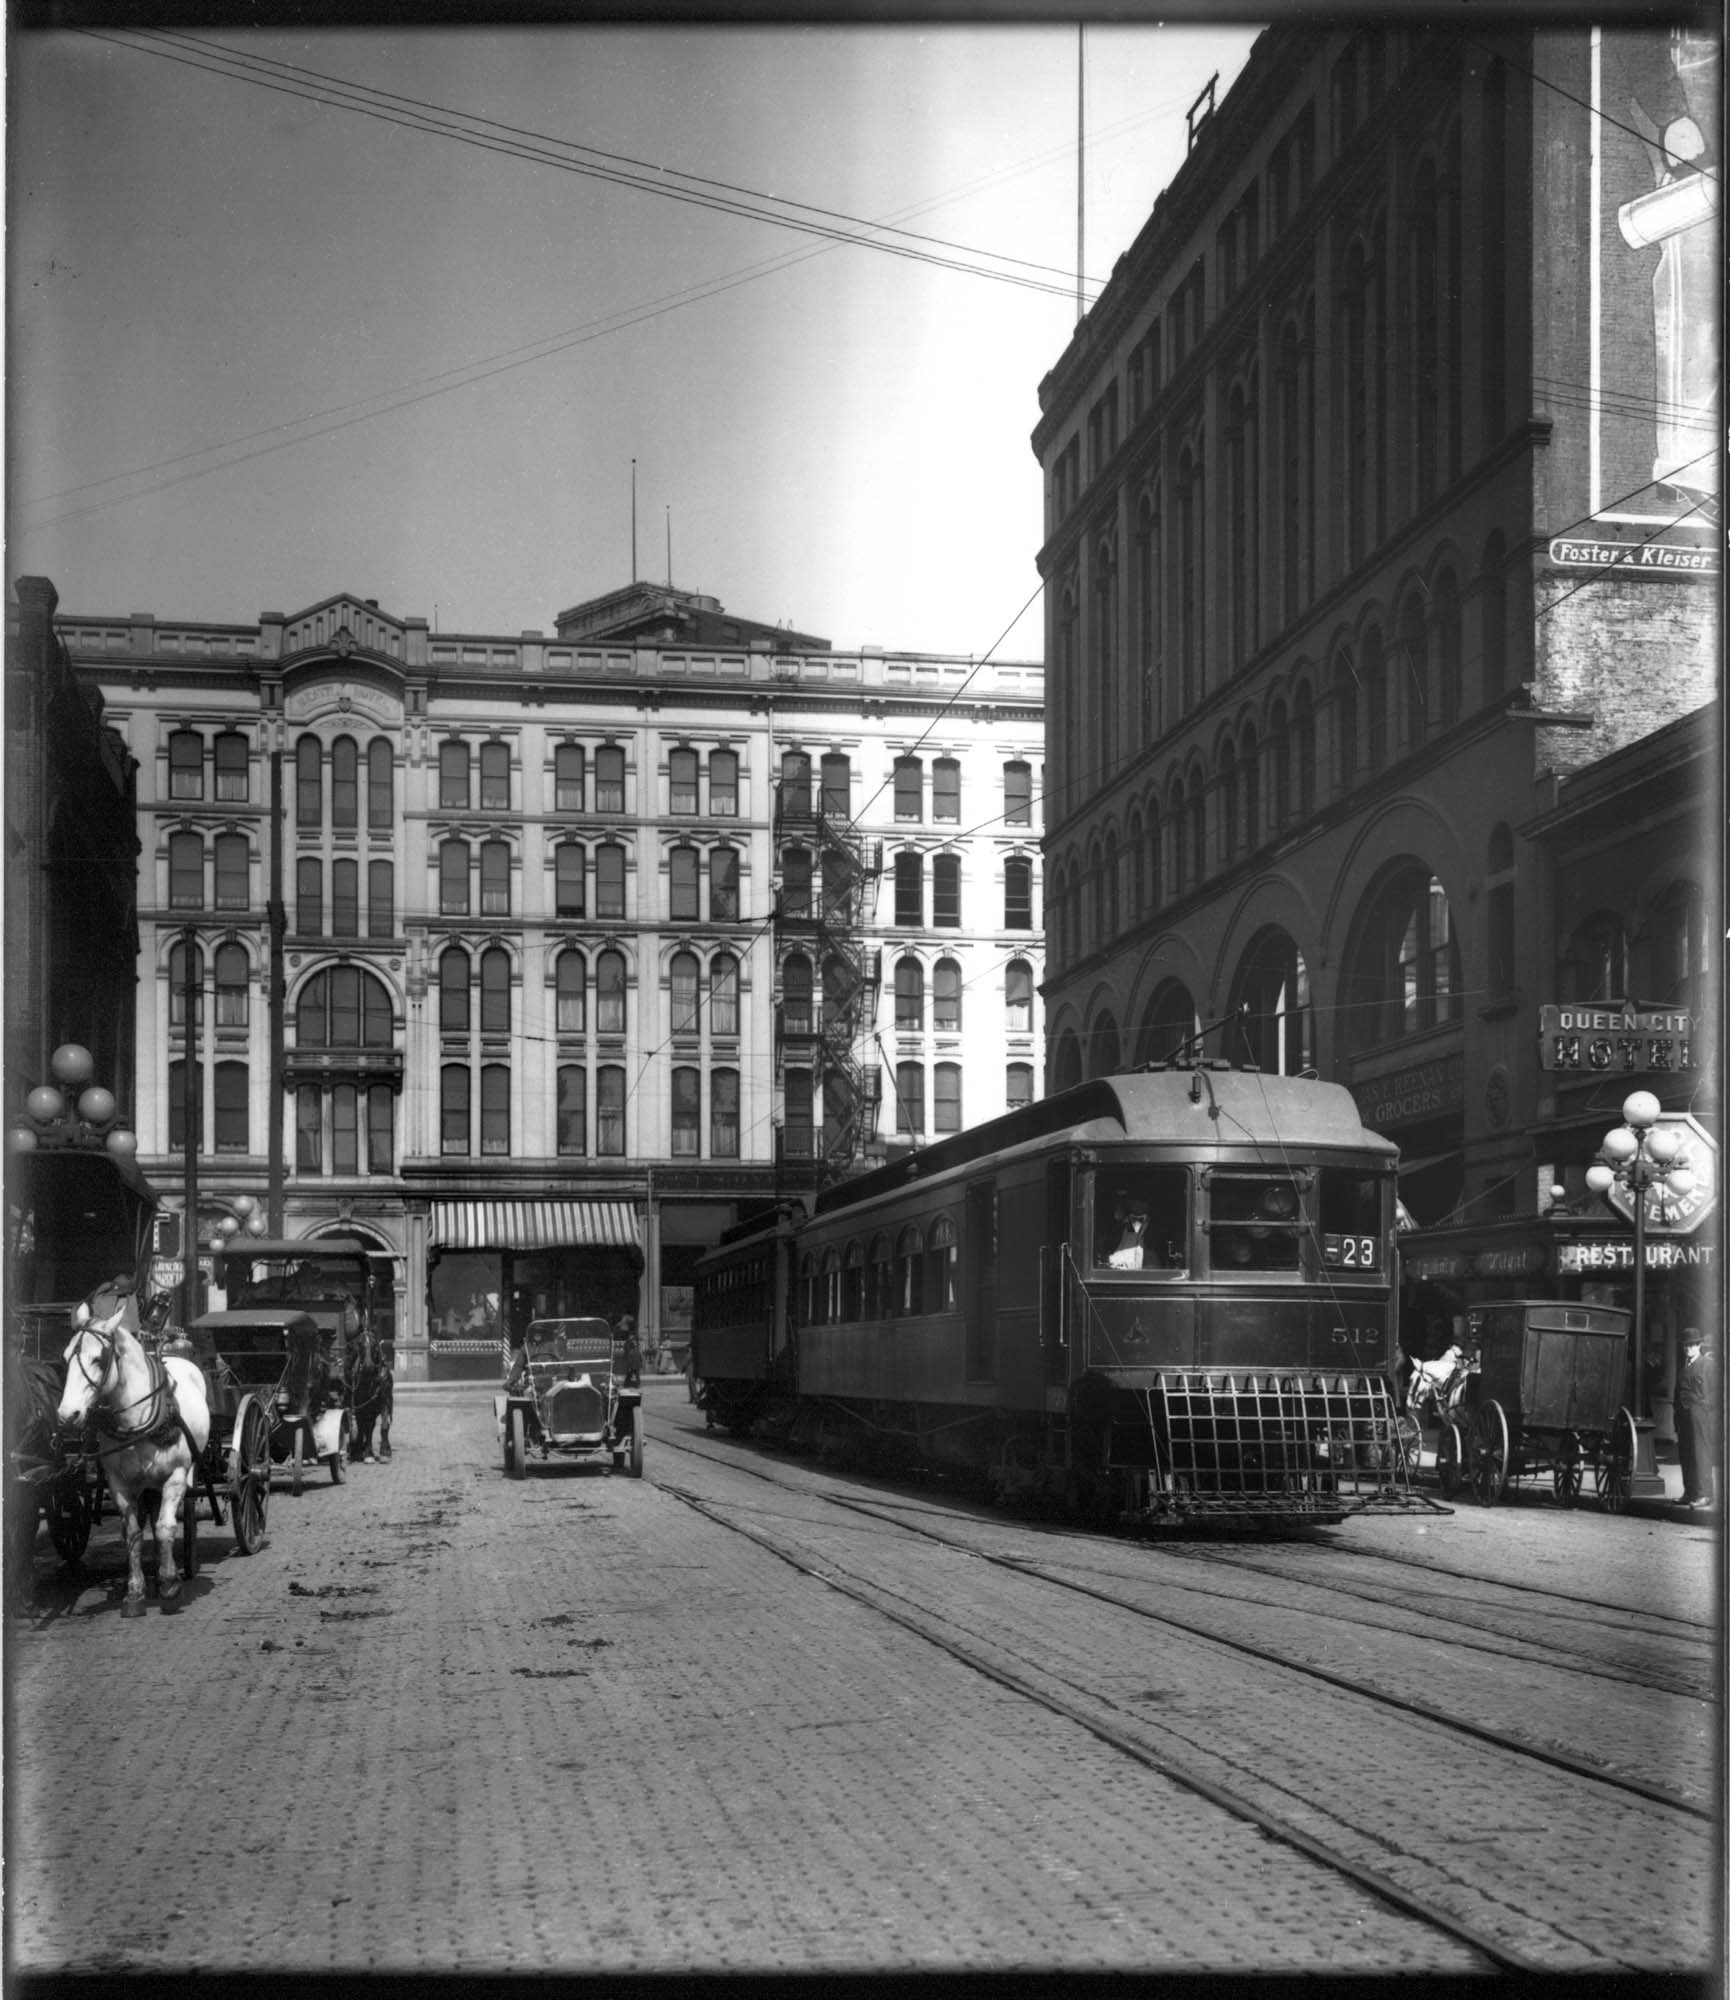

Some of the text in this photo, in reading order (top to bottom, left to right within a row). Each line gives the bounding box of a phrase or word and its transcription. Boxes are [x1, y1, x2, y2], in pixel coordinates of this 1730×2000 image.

[1559, 543, 1619, 562] Foster
[1641, 547, 1712, 569] Kleiser
[1560, 1012, 1703, 1033] QUEEN CITY
[1375, 1089, 1441, 1122] GROCERS
[1576, 1245, 1715, 1267] RESTURANT
[1331, 1328, 1380, 1345] 512
